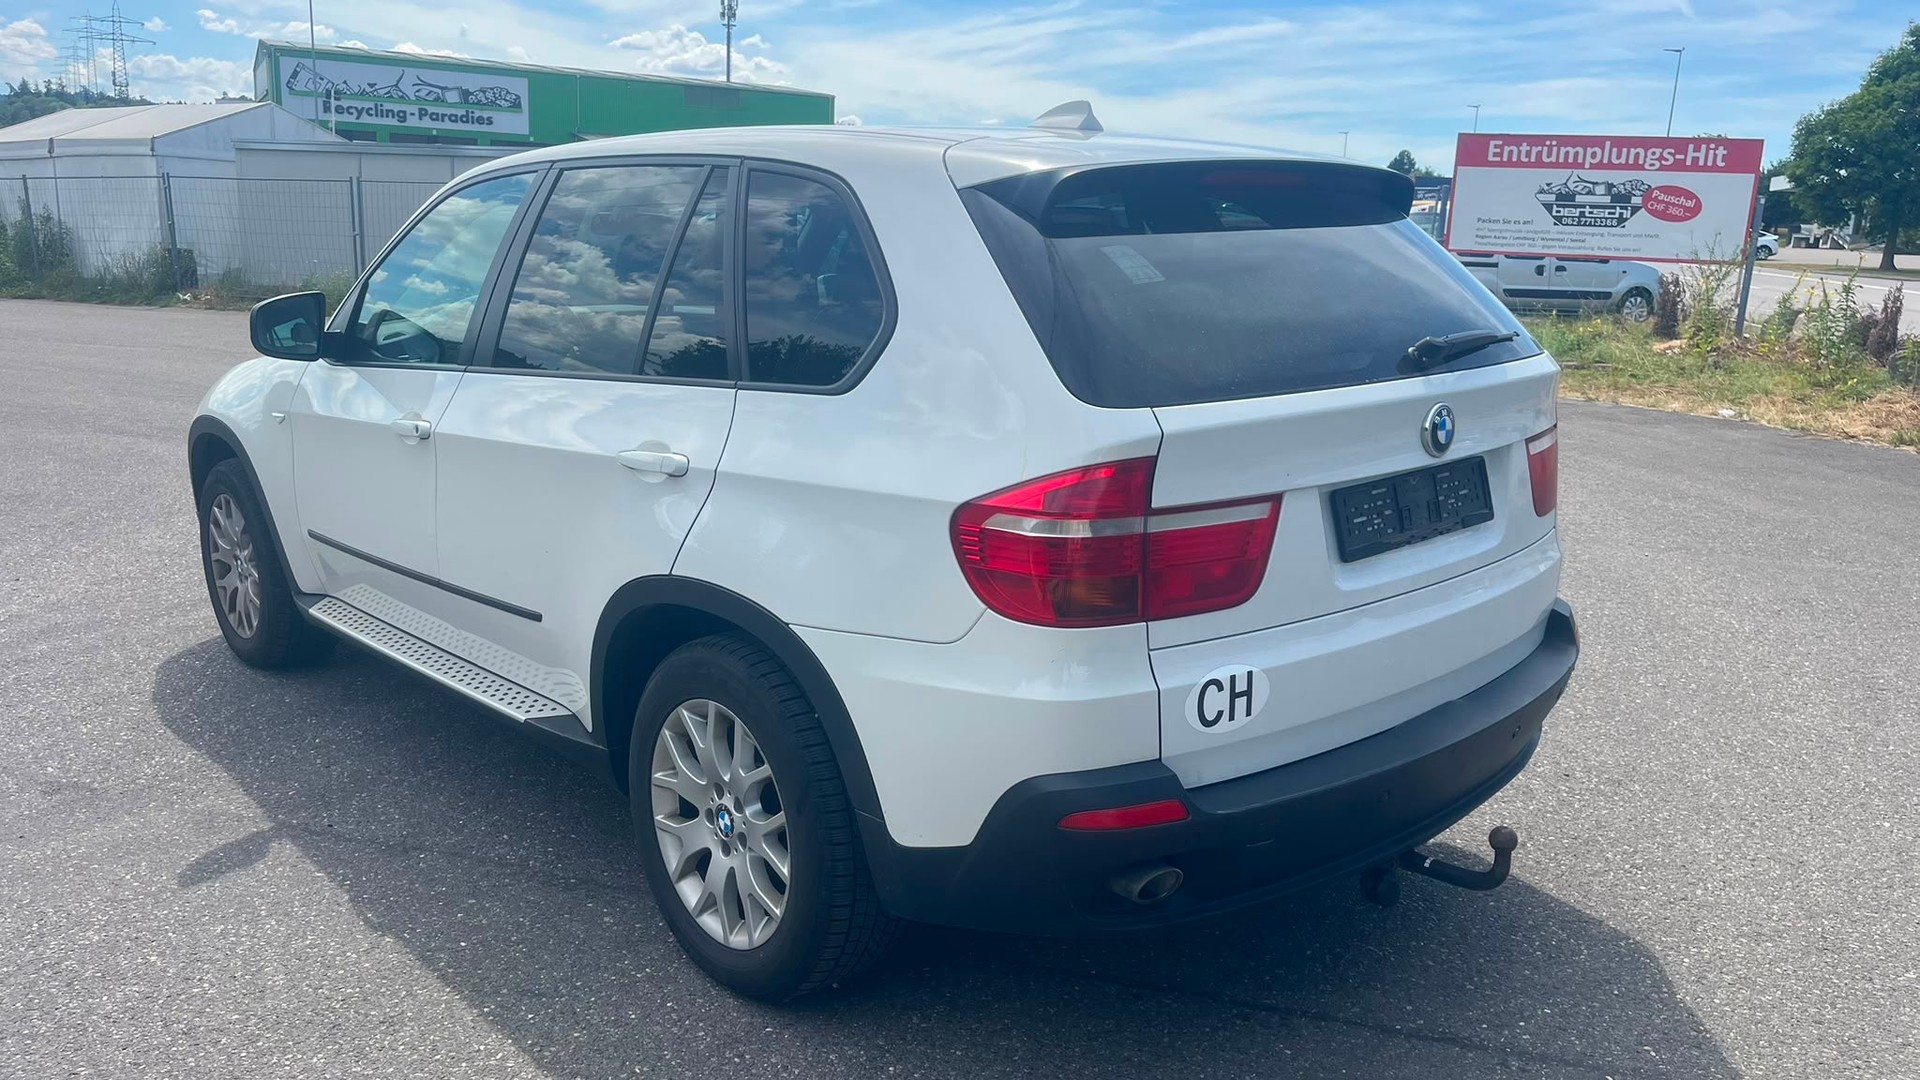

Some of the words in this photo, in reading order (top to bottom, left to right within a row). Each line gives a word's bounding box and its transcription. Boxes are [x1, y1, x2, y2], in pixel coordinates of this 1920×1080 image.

[1487, 140, 1727, 170] Entrümplungs-Hit
[1647, 200, 1665, 211] CHF
[1651, 189, 1696, 208] Pauschal
[1552, 204, 1632, 218] bertschi
[1561, 217, 1578, 225] 062
[1580, 217, 1618, 226] 7713366
[1197, 670, 1253, 728] CH
